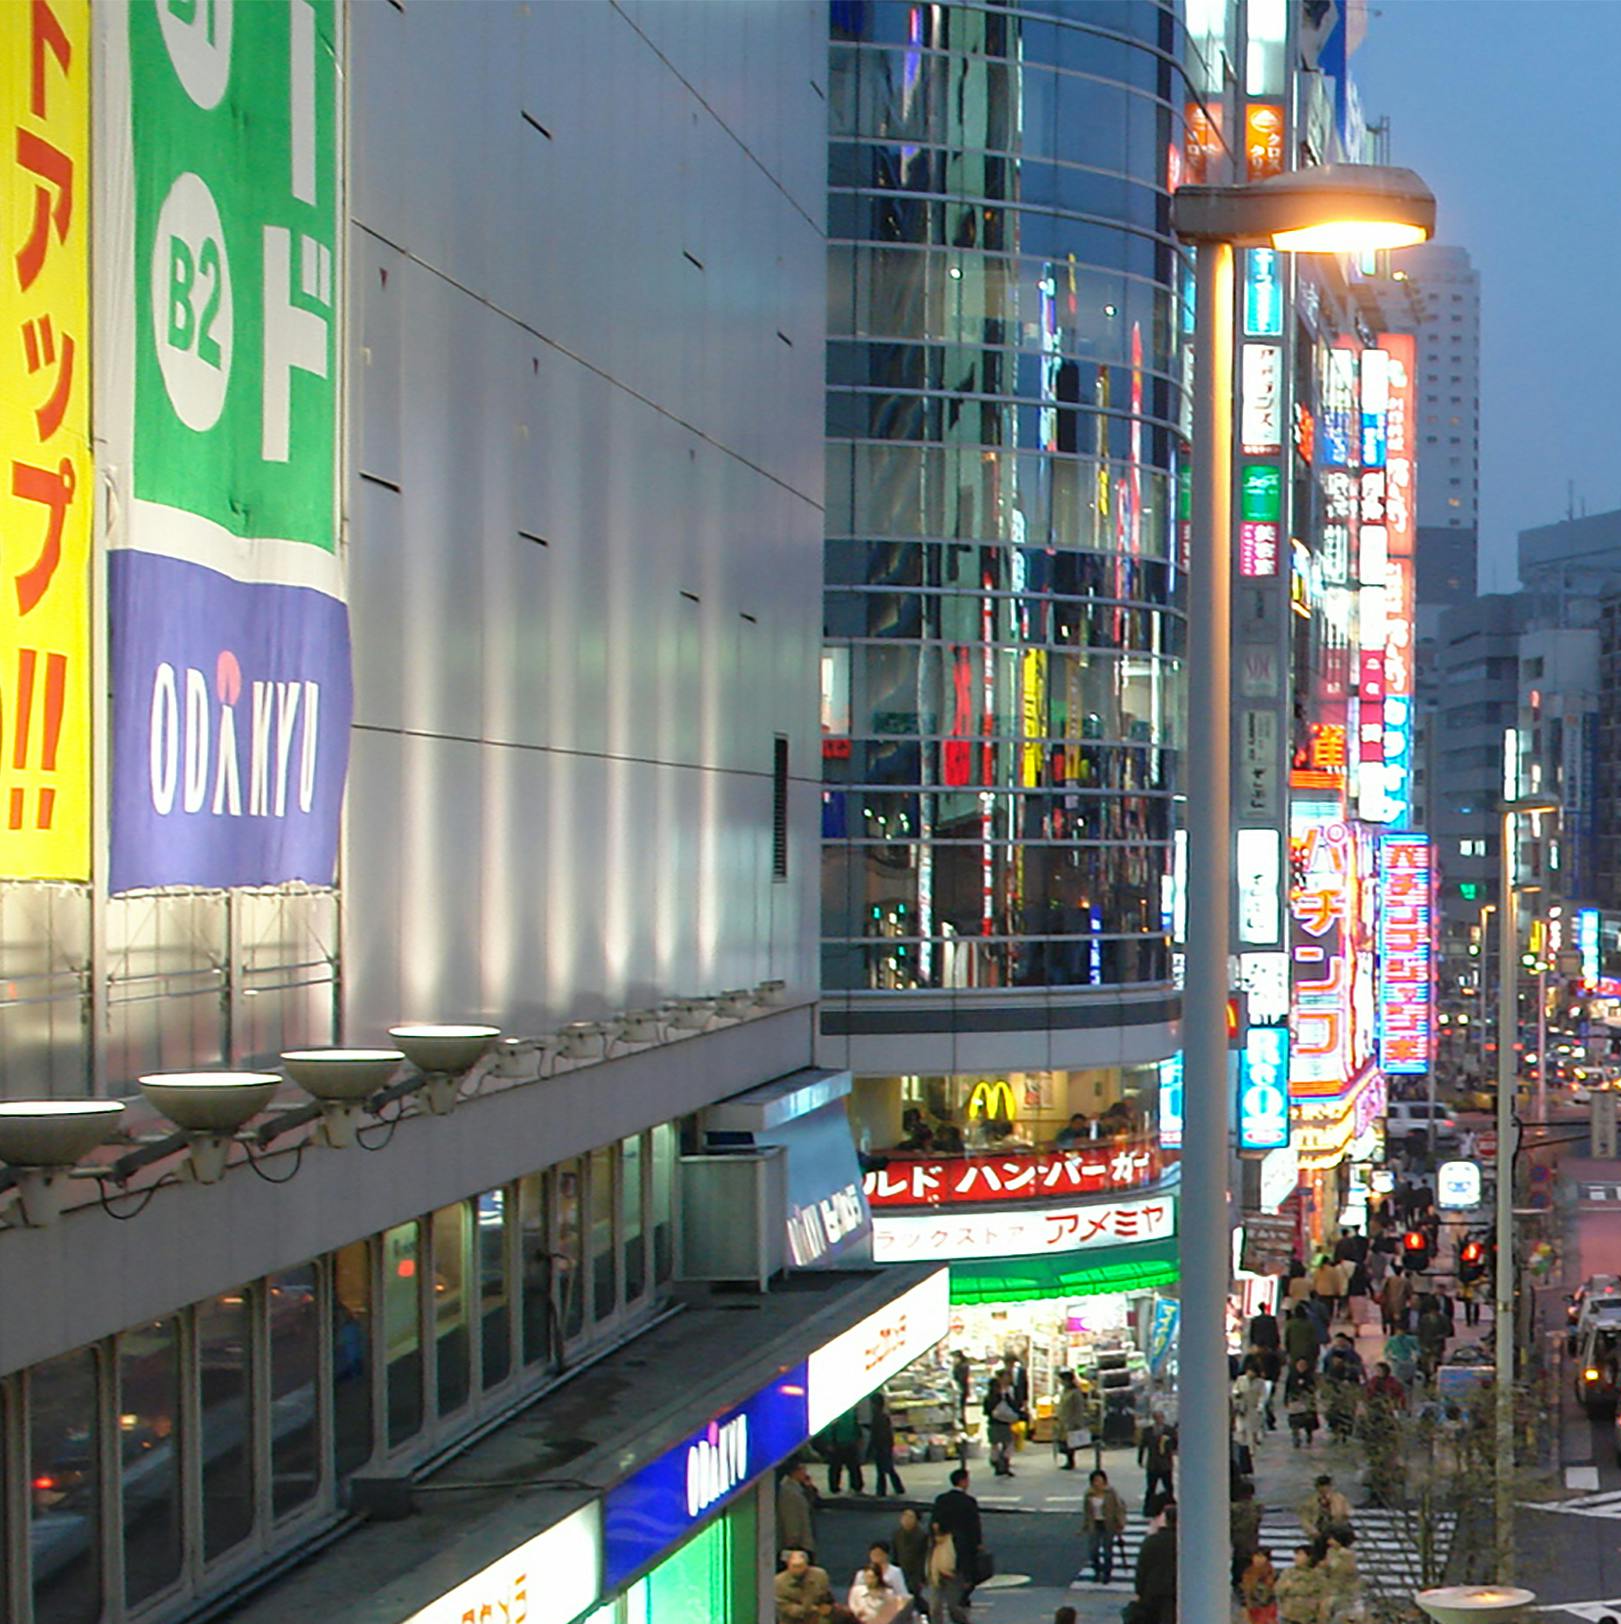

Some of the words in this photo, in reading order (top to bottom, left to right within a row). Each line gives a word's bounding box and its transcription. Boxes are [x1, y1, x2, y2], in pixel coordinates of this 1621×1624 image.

[168, 234, 224, 372] B2
[150, 650, 320, 818] ODAKYU
[955, 1151, 1151, 1194] ハンバーガー
[1044, 1205, 1165, 1245] アメミヤ
